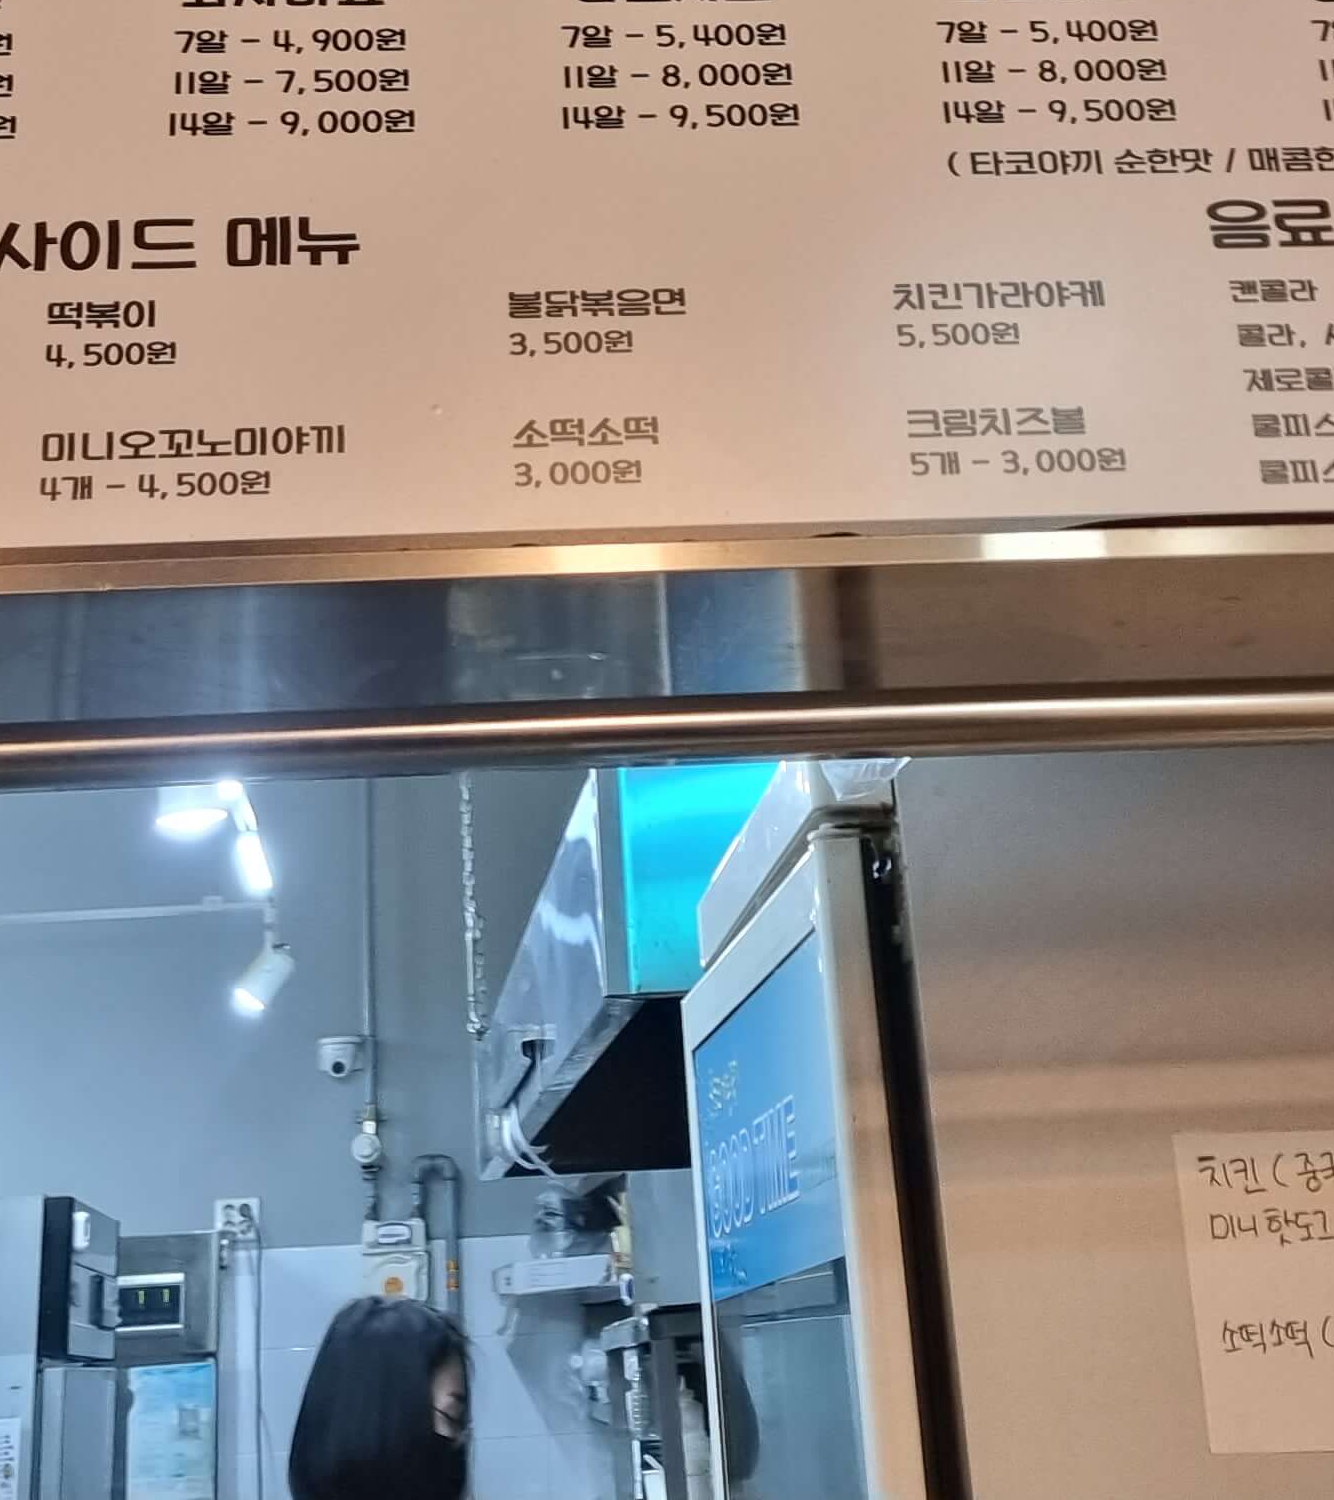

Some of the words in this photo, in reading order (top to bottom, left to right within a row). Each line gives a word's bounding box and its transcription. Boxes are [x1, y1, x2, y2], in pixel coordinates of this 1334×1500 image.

[174, 29, 229, 54] 7알
[560, 24, 614, 49] 7알
[936, 20, 989, 44] 7알
[174, 70, 232, 95] 11알
[564, 64, 619, 89] 11알
[941, 59, 996, 84] 11알
[169, 111, 236, 137] 14알
[562, 105, 626, 130] 14알
[942, 99, 1006, 125] 14알
[226, 215, 361, 268] 메뉴
[47, 299, 156, 330] 떡볶이
[508, 287, 687, 319] 불닭볶음면
[512, 415, 660, 449] 소떡소떡
[906, 405, 1087, 439] 크림치즈볼
[41, 424, 345, 462] 미니오꼬노미야끼
[909, 450, 961, 477] 5개
[39, 475, 93, 502] 4개
